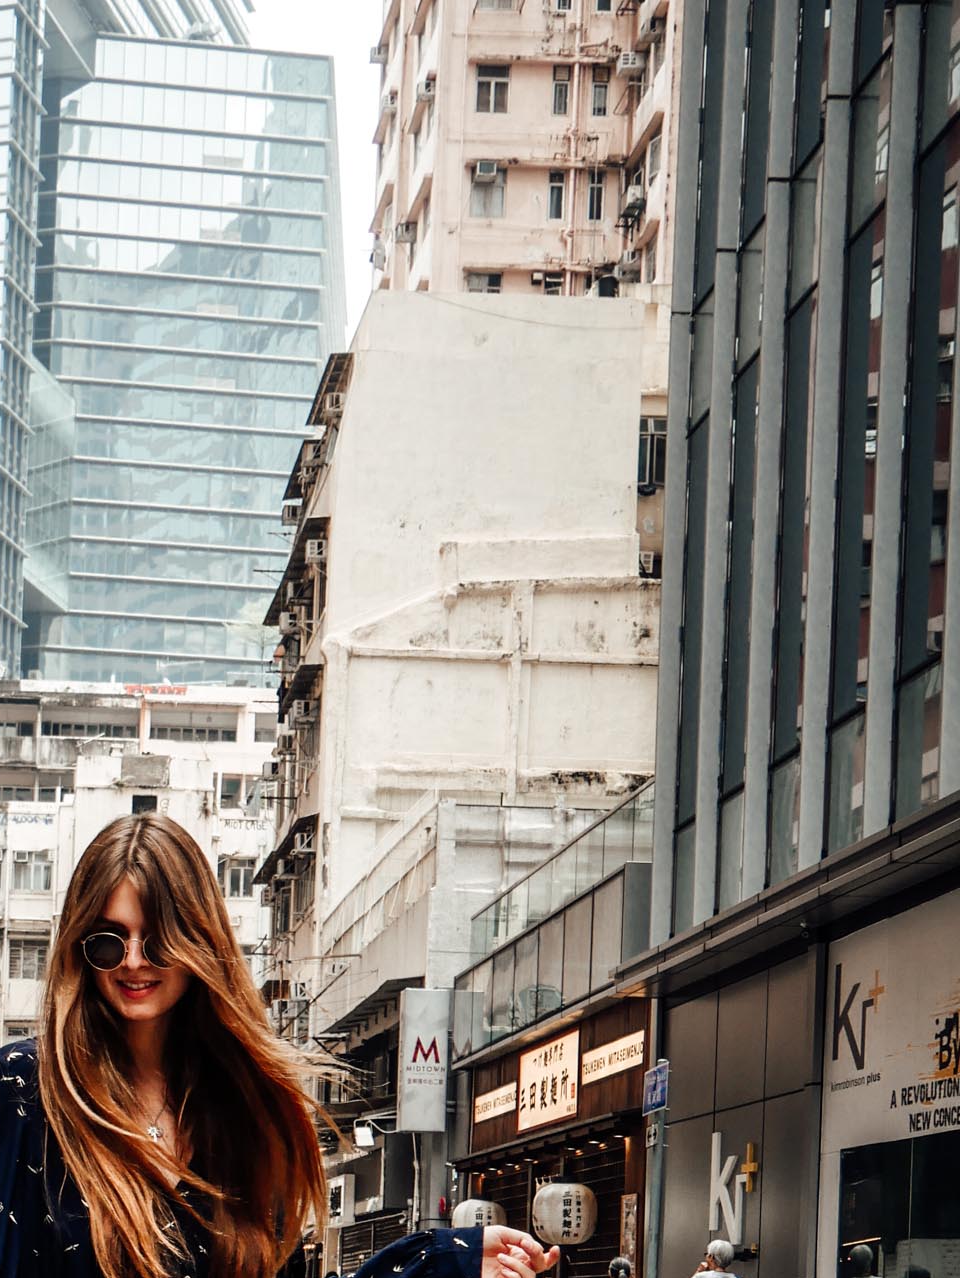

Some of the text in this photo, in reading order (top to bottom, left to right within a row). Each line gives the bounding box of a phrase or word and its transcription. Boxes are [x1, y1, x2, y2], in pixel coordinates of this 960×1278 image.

[412, 1036, 440, 1063] M
[406, 1065, 446, 1073] MIDTOWN
[867, 1072, 881, 1086] plus
[890, 1078, 960, 1109] A REVOLUTION
[909, 1111, 931, 1133] NEW
